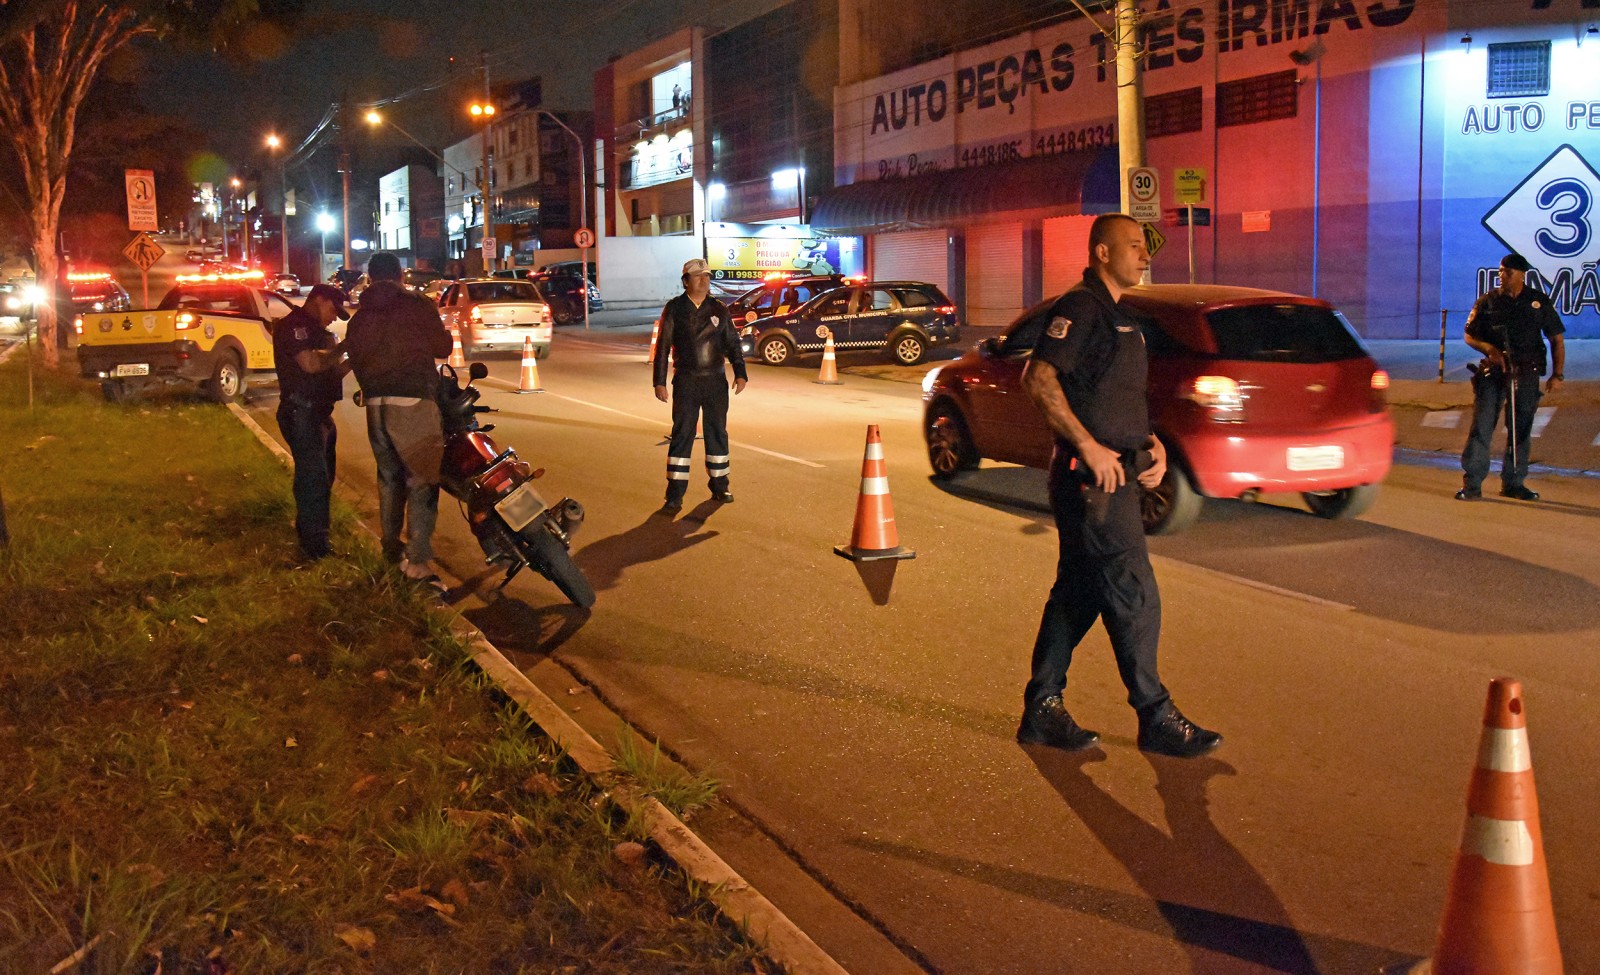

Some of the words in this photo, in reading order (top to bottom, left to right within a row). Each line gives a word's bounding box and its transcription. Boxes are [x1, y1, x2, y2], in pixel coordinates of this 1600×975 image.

[871, 79, 947, 135] AUTO
[957, 43, 1075, 115] PEÇAS
[1089, 0, 1204, 83] TÊS
[1461, 102, 1545, 135] AUTO
[1136, 176, 1151, 189] 30
[1534, 177, 1592, 258] 3
[859, 311, 888, 319] MUNICIPAL
